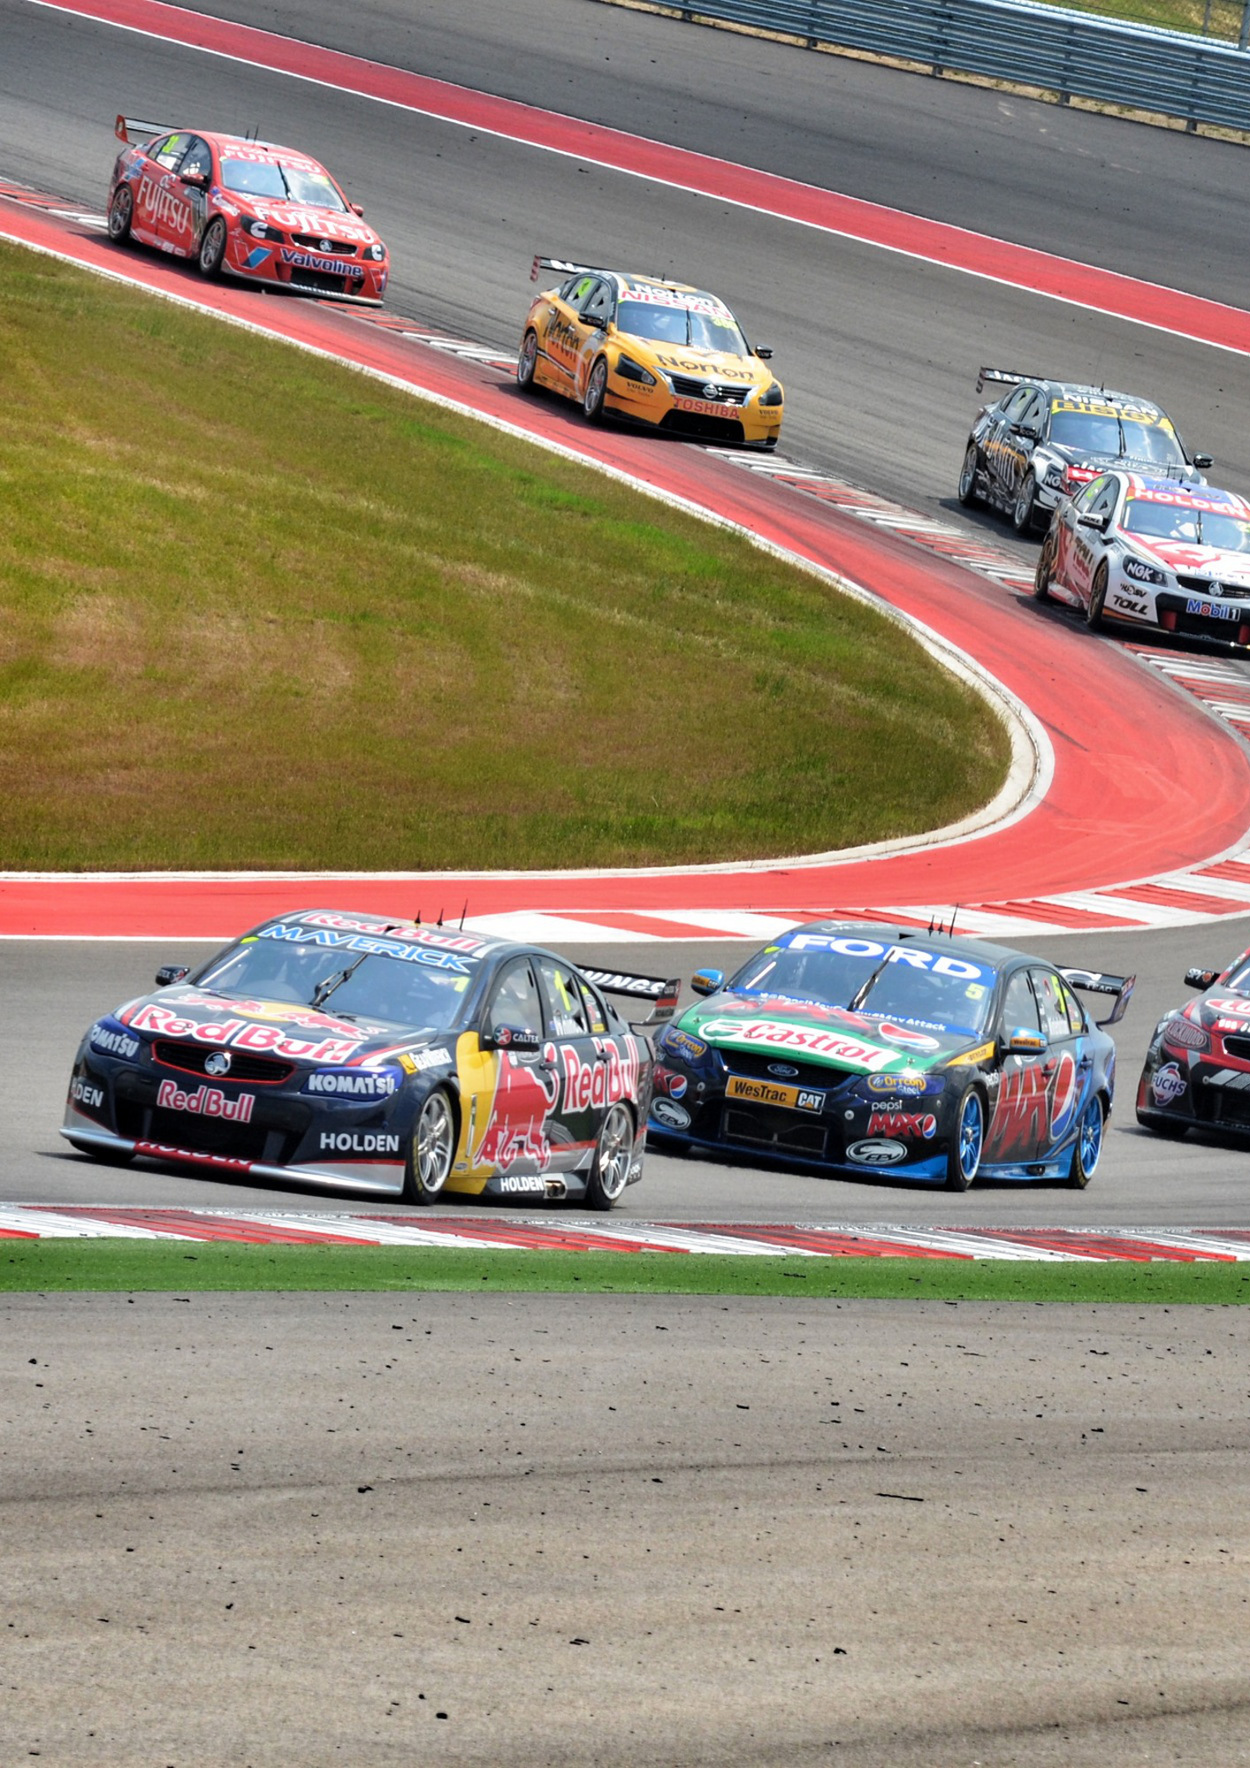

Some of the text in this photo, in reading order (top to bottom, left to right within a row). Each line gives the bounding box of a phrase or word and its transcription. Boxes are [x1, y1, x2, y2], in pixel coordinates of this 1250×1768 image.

[137, 175, 190, 233] FUJITSU
[253, 206, 375, 245] FUJITSU
[280, 248, 363, 278] Valvoline
[621, 290, 730, 318] NISSAN
[654, 353, 754, 381] Norton
[626, 382, 654, 394] VOLVO
[673, 397, 740, 419] TOSHIBA
[1063, 394, 1159, 417] NISSAN
[1044, 474, 1060, 486] NG
[1134, 488, 1248, 519] HOLDEN
[1126, 562, 1154, 581] NGK
[1113, 594, 1149, 616] TOLL
[1186, 600, 1230, 620] Mobil
[257, 924, 480, 974] MAVERICK
[788, 933, 982, 980] FORD
[450, 976, 471, 993] 1
[964, 982, 986, 1001] 5
[90, 1024, 140, 1058] OMATSU
[128, 1004, 237, 1045] Red
[231, 1023, 363, 1064] Bull
[513, 1034, 539, 1044] CALTEX
[743, 1021, 884, 1064] Castrol
[1167, 1021, 1205, 1047] LOCKWOOD
[308, 1073, 396, 1095] KOMATSU
[733, 1081, 787, 1103] WesTrac
[1154, 1073, 1186, 1095] FUCHS
[156, 1079, 256, 1124] Red Bull
[797, 1091, 823, 1110] CAT
[871, 1101, 902, 1112] pepsi
[867, 1111, 924, 1138] MAX
[319, 1132, 400, 1152] HOLDEN
[500, 1176, 545, 1193] HOLDEN
